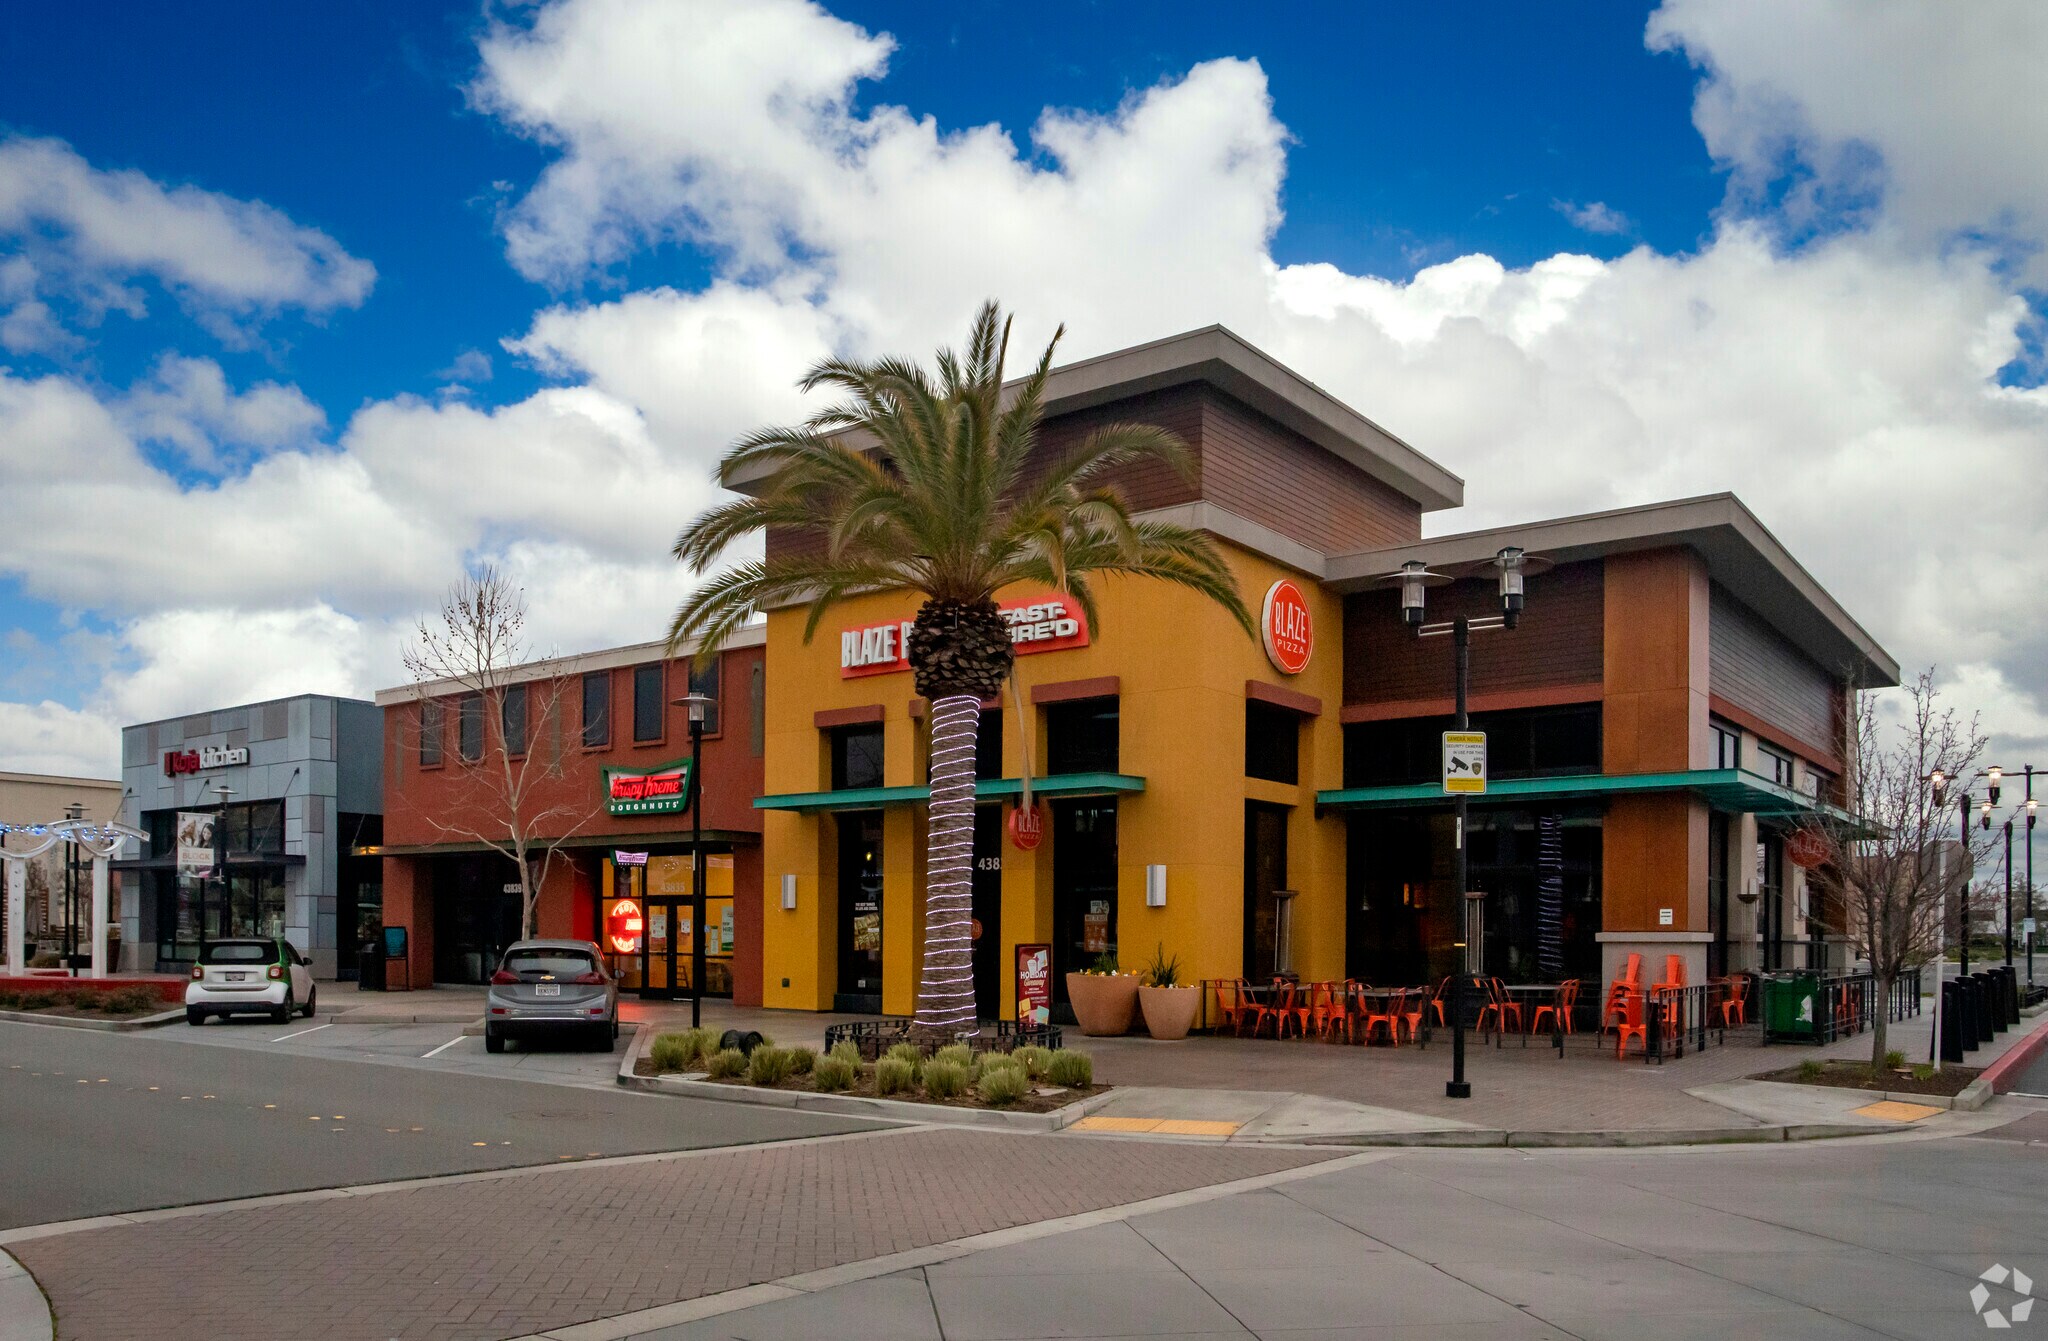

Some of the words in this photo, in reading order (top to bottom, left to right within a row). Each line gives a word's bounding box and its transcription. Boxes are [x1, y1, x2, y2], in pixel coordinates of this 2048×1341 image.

[1009, 618, 1079, 643] IRE'D
[1275, 601, 1306, 643] BLAZE
[841, 625, 898, 667] BLAZE
[1277, 639, 1305, 655] PIZZA
[610, 777, 645, 800] Krispy
[644, 773, 684, 797] Kreme
[978, 857, 1002, 871] 438
